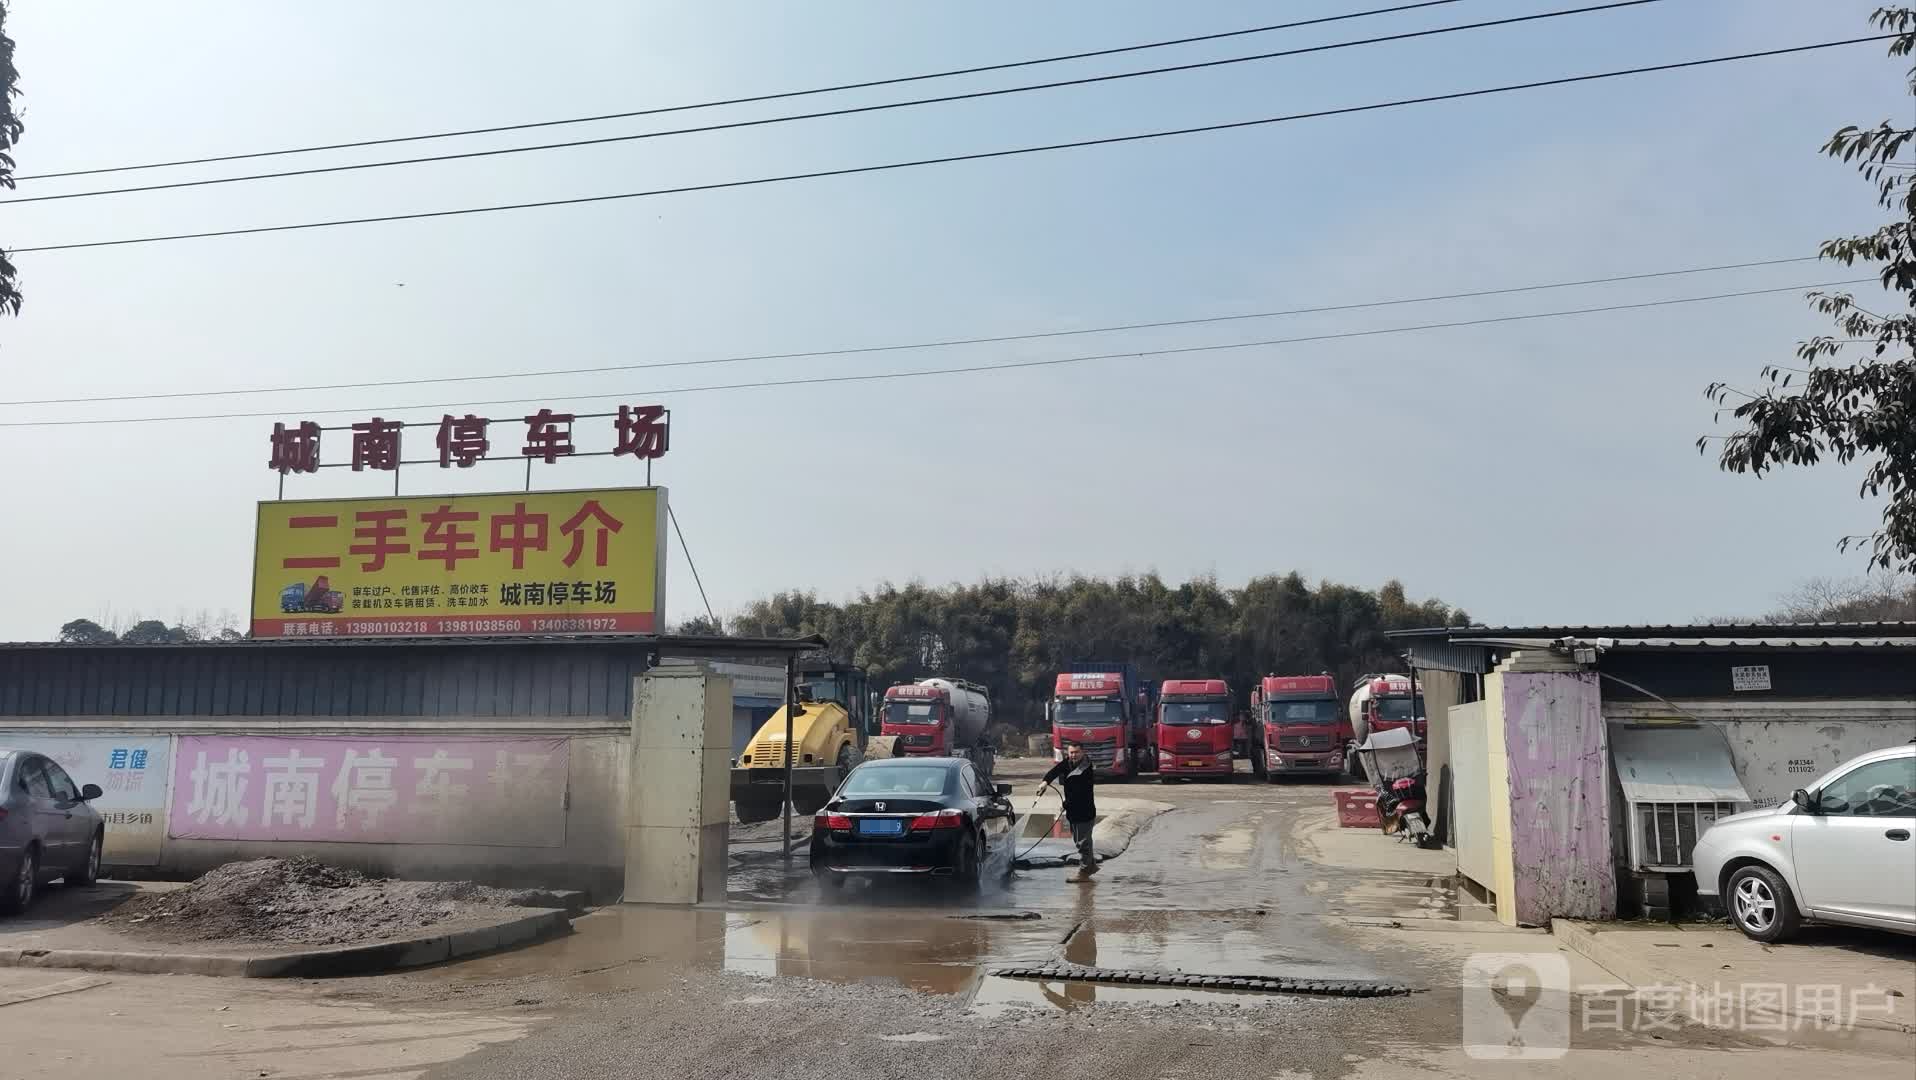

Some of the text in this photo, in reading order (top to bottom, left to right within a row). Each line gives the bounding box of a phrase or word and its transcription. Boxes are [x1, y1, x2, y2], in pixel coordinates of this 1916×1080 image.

[269, 405, 668, 475] 城南停车场
[283, 500, 625, 572] 二手车中介
[500, 581, 617, 607] 城南停车场
[346, 621, 428, 634] 13980103218
[438, 619, 521, 632] 13981038560
[108, 748, 149, 770] 君健
